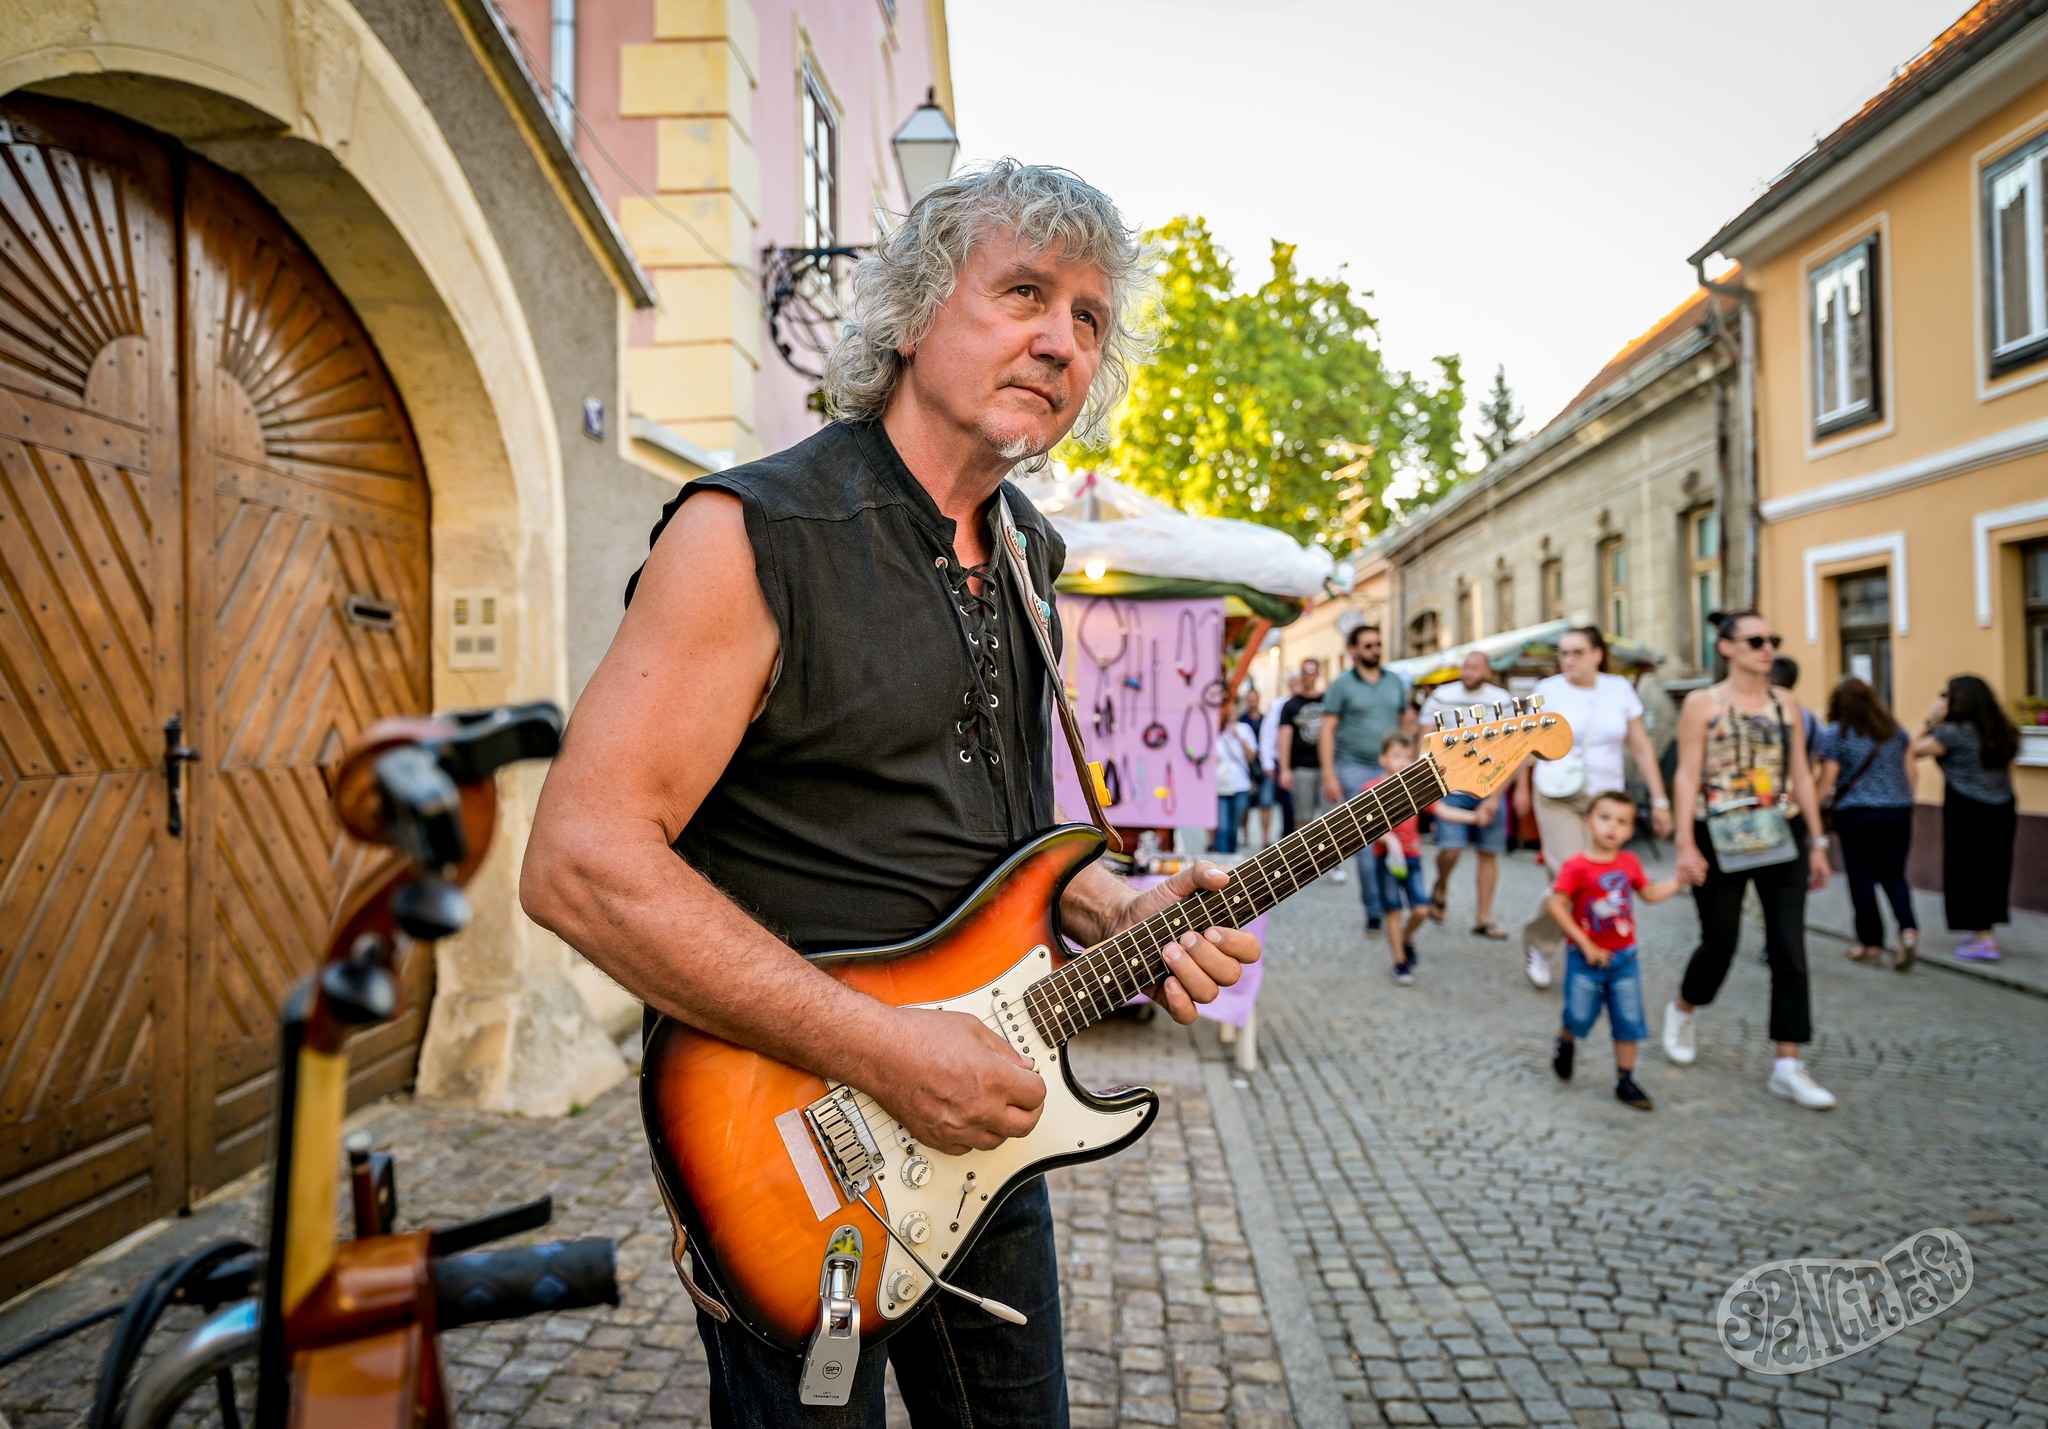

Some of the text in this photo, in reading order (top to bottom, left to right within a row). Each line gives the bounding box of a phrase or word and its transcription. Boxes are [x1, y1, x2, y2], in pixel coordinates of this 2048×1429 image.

[914, 1166, 928, 1184] VOLUME
[914, 1226, 926, 1239] TONE
[902, 1283, 913, 1296] TONE
